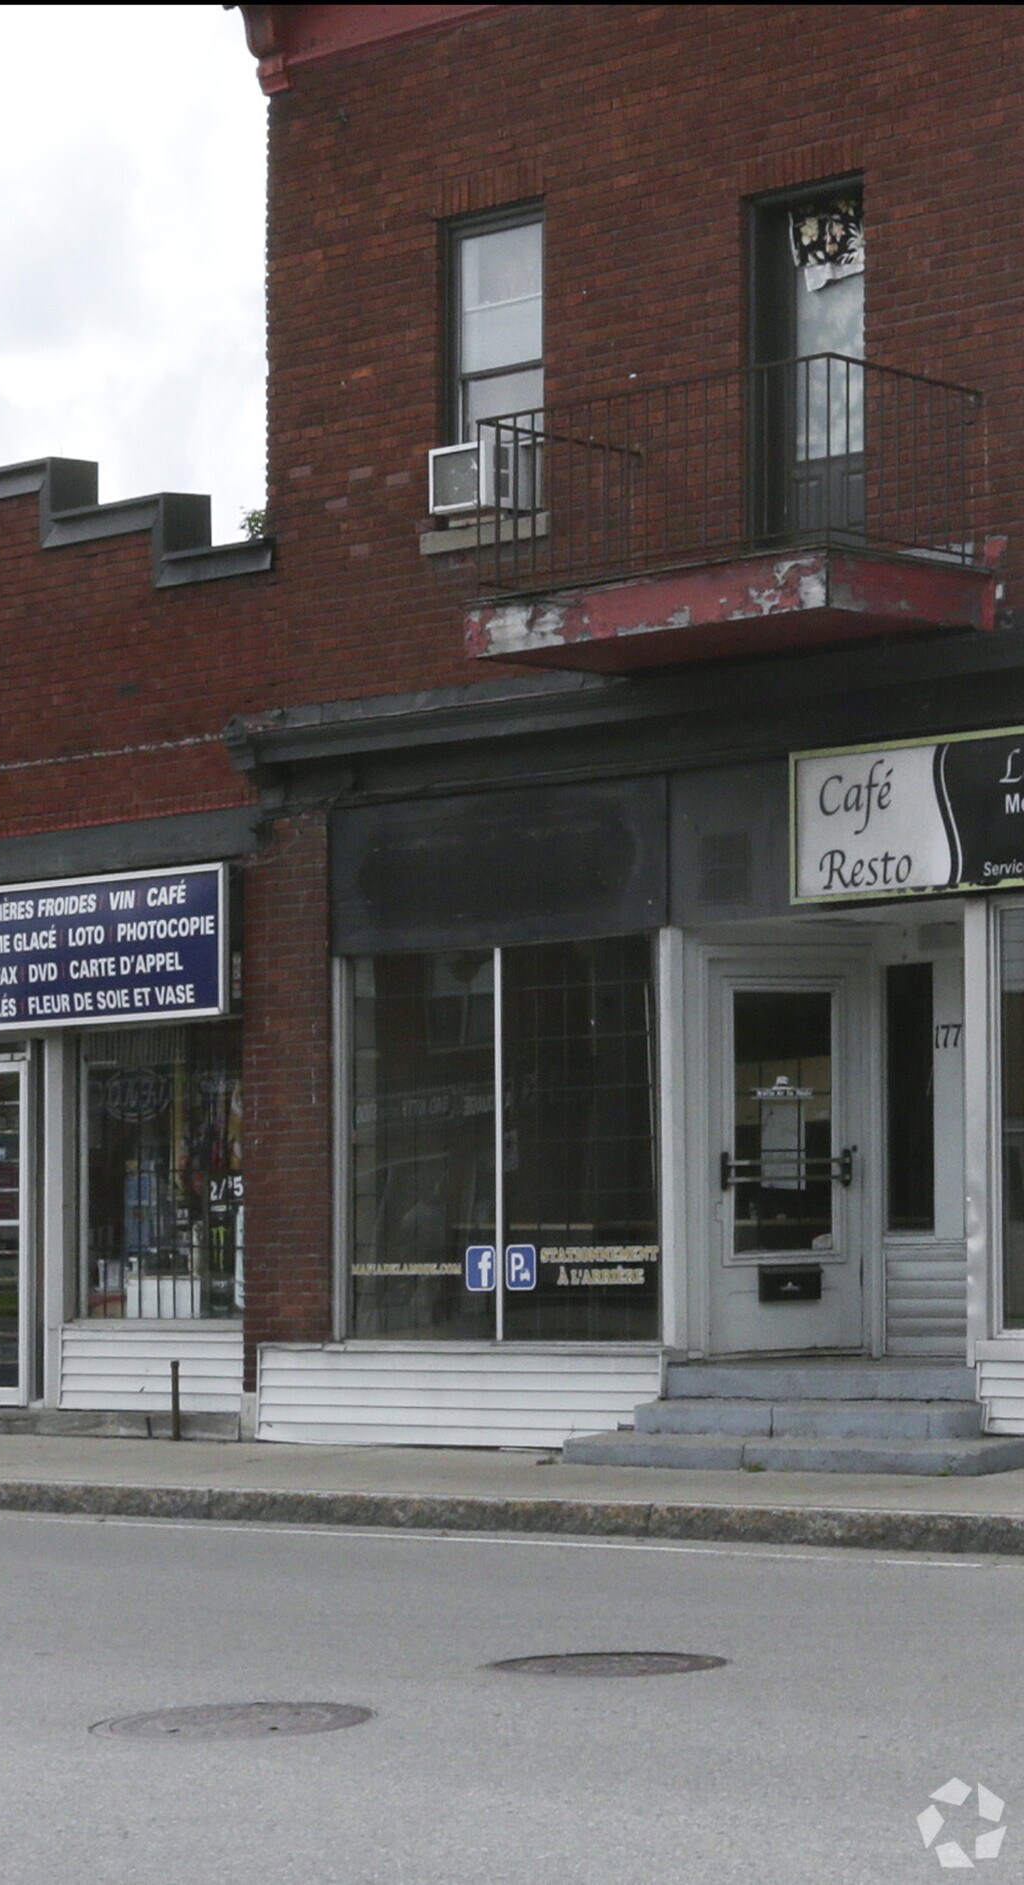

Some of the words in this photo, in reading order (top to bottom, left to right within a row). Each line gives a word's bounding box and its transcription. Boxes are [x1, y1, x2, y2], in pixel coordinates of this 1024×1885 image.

[819, 759, 894, 835] Café
[819, 849, 912, 890] Resto
[37, 893, 97, 918] FROIDES
[109, 890, 136, 911] VIN
[146, 879, 187, 907] CAFÉ
[13, 925, 57, 952] GLACÉ
[68, 926, 105, 947] LOTO
[117, 915, 215, 943] PHOTOCOPIE
[28, 962, 58, 983] DVD
[69, 957, 116, 979] CARTE
[120, 951, 184, 976] D'APPEL
[28, 995, 71, 1015] FLEUR
[73, 993, 93, 1012] DE
[96, 988, 130, 1010] SOIE
[133, 987, 151, 1007] ET
[154, 983, 195, 1004] VASE
[935, 1024, 963, 1048] 177
[511, 1253, 524, 1282] P
[540, 1245, 660, 1263] STATIONNEMENT
[557, 1265, 569, 1286] À
[570, 1265, 645, 1286] L'ARRIÈRE
